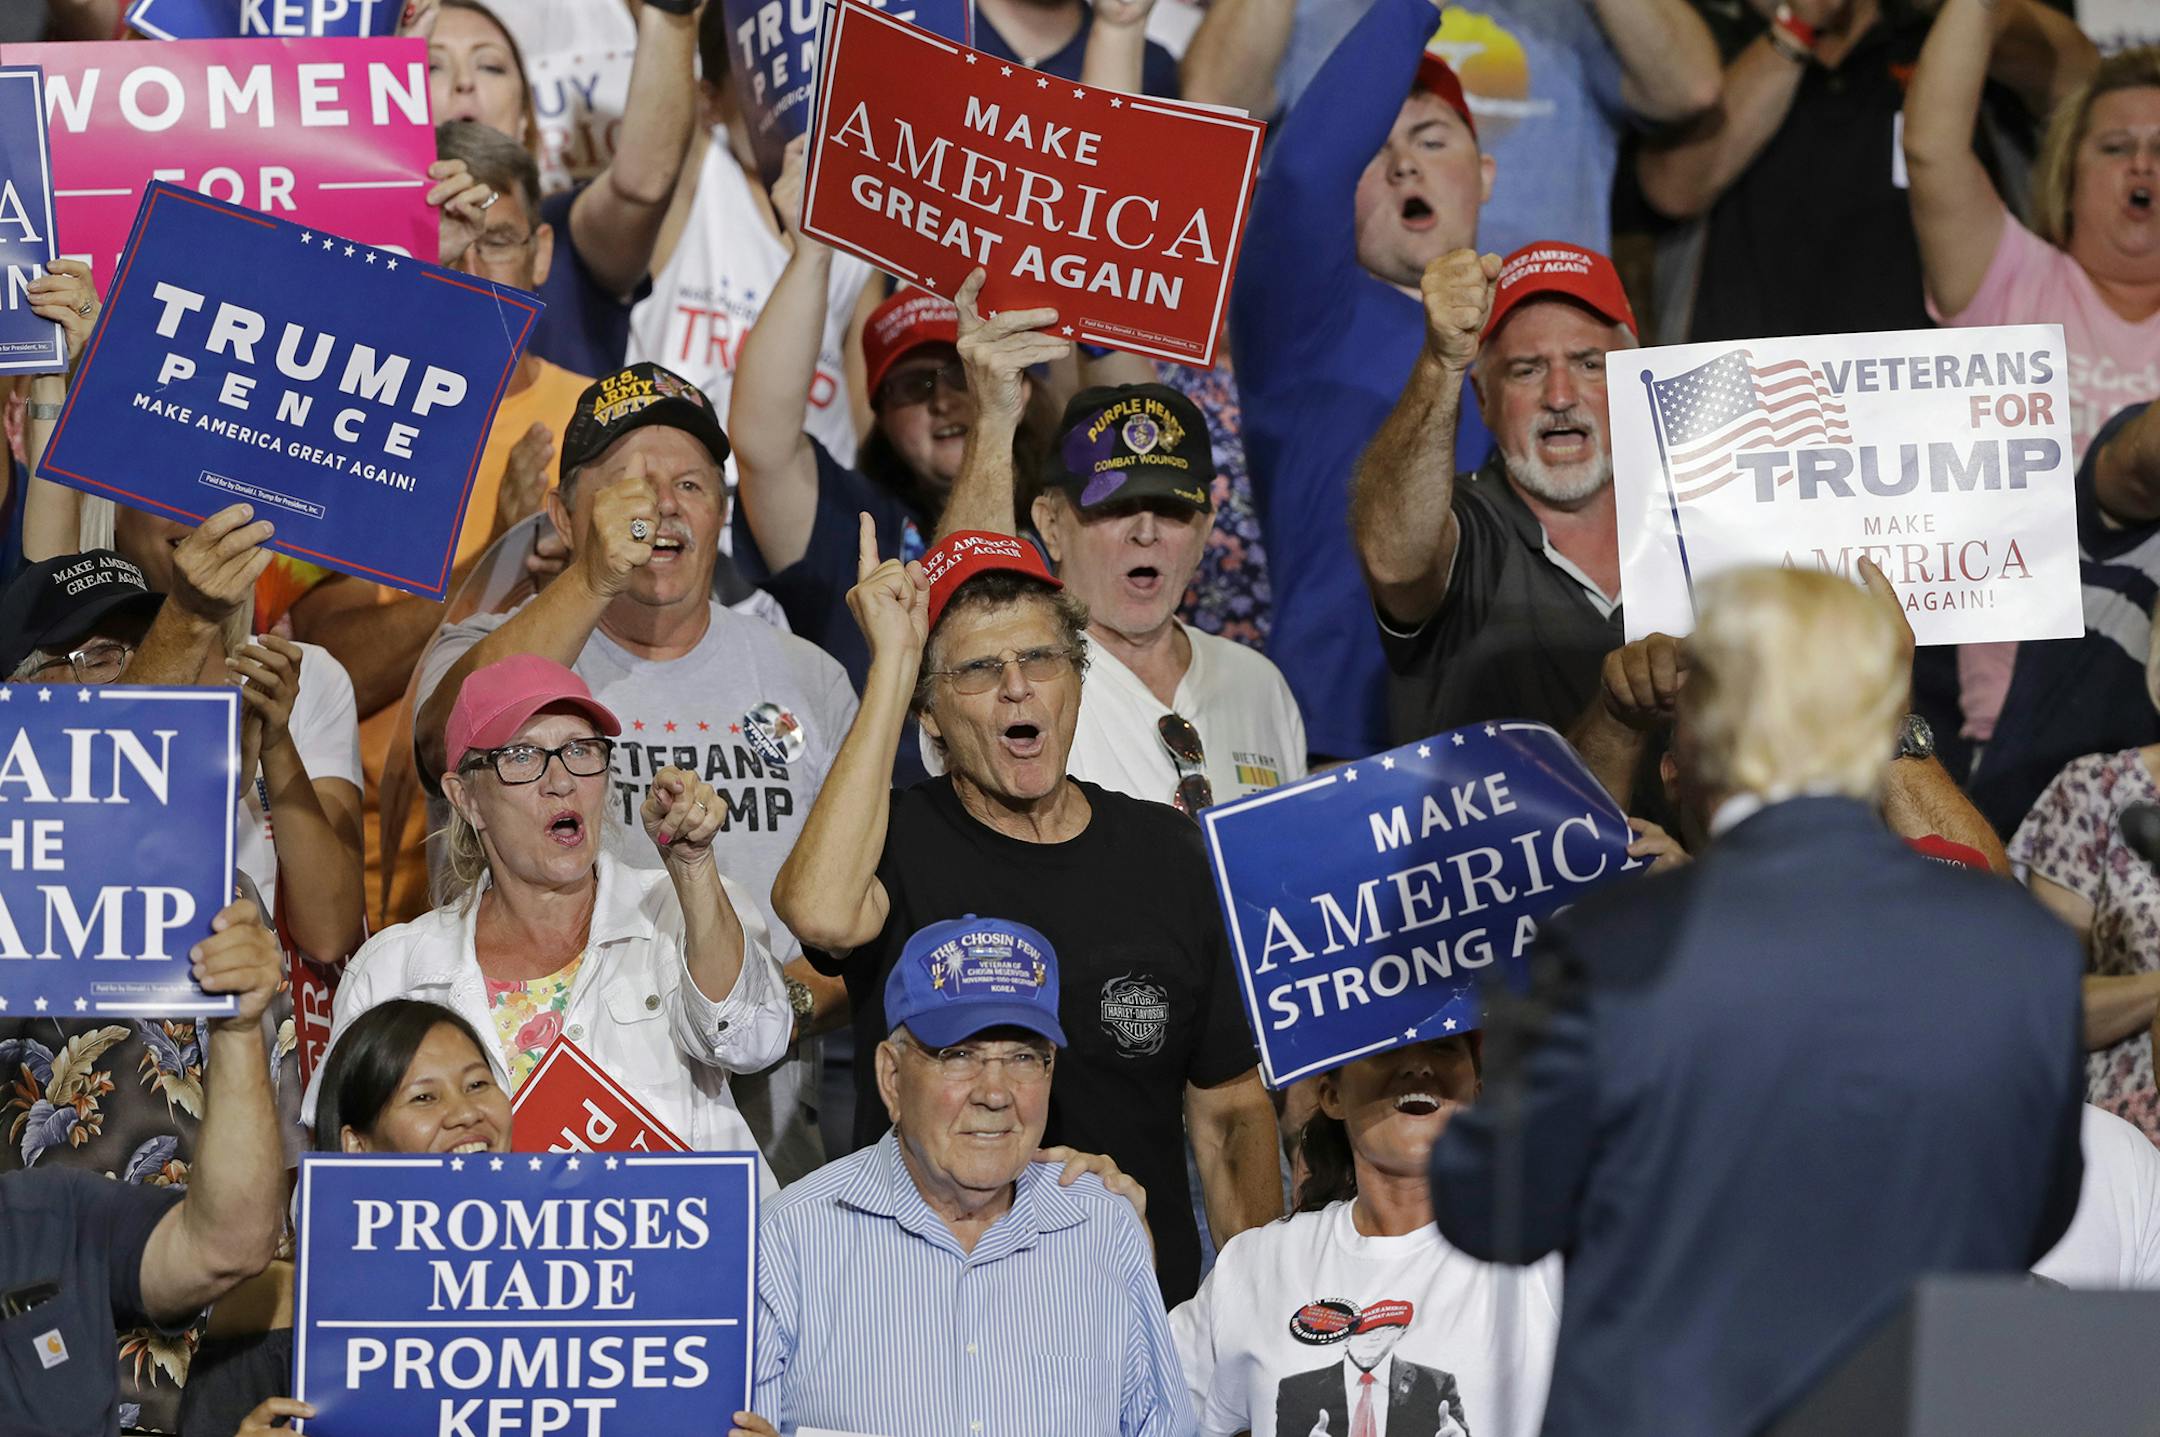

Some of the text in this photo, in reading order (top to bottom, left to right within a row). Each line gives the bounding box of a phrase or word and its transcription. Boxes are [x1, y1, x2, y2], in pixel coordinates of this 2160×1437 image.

[239, 0, 383, 38] KEPT
[44, 62, 430, 133] WOMEN
[963, 96, 1102, 167] MAKE
[829, 101, 1221, 265] AMERICA
[850, 174, 1184, 311] GREAT AGAIN
[153, 282, 468, 416] TRUMP
[600, 369, 639, 391] U.S.
[1821, 350, 2054, 395] VETERANS
[157, 352, 421, 460] PENCE
[592, 380, 653, 415] ARMY
[1969, 393, 2055, 429] FOR
[1087, 398, 1185, 443] PURPLE HEART
[132, 392, 417, 492] MAKE AMERICA GREAT AGAIN!
[1094, 453, 1189, 473] COMBAT WOUNDED
[205, 474, 219, 485] Paid
[258, 490, 274, 502] Trump
[1736, 437, 2062, 503] TRUMP
[952, 536, 1023, 552] AMERICA
[1863, 513, 1936, 536] MAKE
[52, 559, 95, 584] MAKE
[66, 571, 113, 595] GREAT
[929, 545, 1023, 585] REAT AGAIN
[1905, 589, 1995, 612] AGAIN!
[1369, 772, 1518, 854] MAKE
[1255, 813, 1643, 976] AMERIC
[930, 932, 1041, 962] THE CHOSIN FEW
[991, 984, 1016, 993] KOREA
[1266, 927, 1494, 1031] STRONG
[1107, 1006, 1164, 1020] HARLEY-DAVIDSON
[351, 1197, 710, 1251] PROMISES
[427, 1258, 636, 1311] MADE
[346, 1335, 710, 1389] PROMISES
[439, 1398, 617, 1437] KEPT
